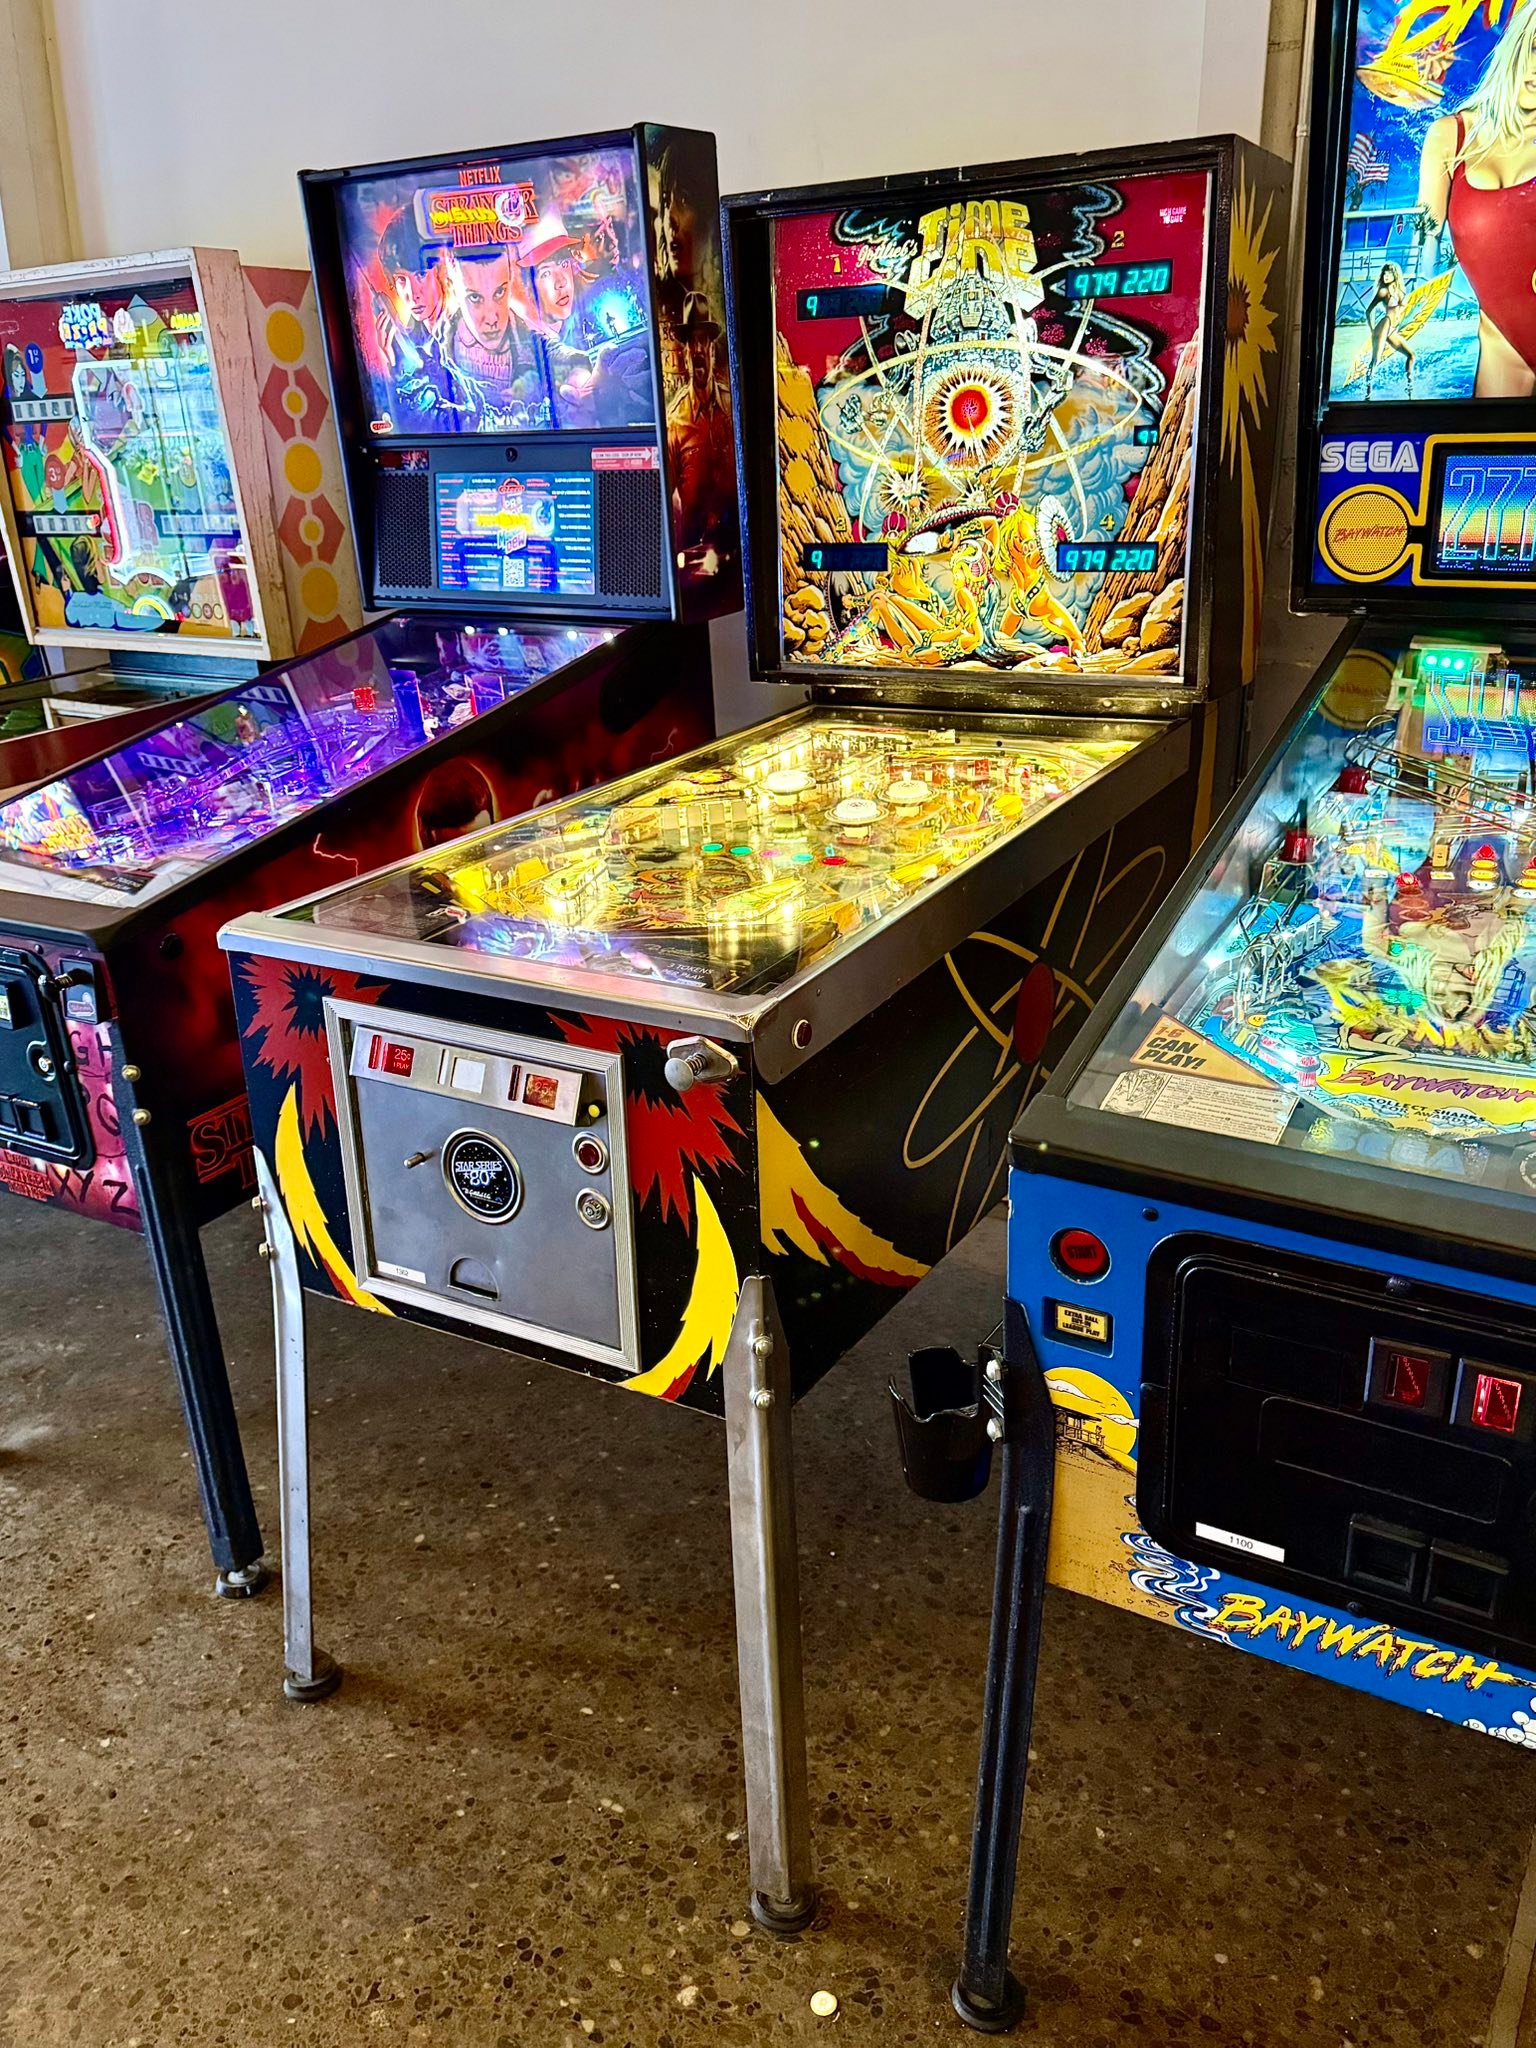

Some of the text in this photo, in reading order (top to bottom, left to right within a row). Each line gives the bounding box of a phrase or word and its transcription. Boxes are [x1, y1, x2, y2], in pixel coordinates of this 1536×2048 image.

[459, 166, 501, 187] NETFLIX
[451, 222, 524, 247] THINGS
[918, 199, 1035, 258] TIME
[1111, 230, 1125, 248] 2
[833, 257, 842, 274] 1
[1075, 266, 1170, 297] 979 220
[806, 295, 818, 318] 9
[1138, 429, 1158, 445] 97
[1320, 440, 1419, 473] SEGA
[1100, 513, 1115, 531] 4
[1333, 524, 1409, 544] BAYWATCH
[811, 550, 823, 569] 9
[1066, 549, 1155, 571] 979 220
[676, 964, 715, 975] TOKENS
[681, 971, 705, 980] PLAY
[1156, 1026, 1186, 1039] 1-6
[394, 1048, 411, 1061] 25¢
[1147, 1037, 1199, 1055] CAN
[1139, 1049, 1207, 1070] PLAY!
[1326, 1068, 1536, 1104] BAYWATCH
[1368, 1096, 1428, 1112] COLLECT
[1381, 1104, 1469, 1125] FOR AWARDS
[1433, 1108, 1486, 1122] SHARKS
[456, 1161, 502, 1170] STAR SERIES
[1064, 1309, 1098, 1324] EXTRA BALL
[1062, 1322, 1099, 1337] LEAGUE PLAY
[1230, 1536, 1254, 1550] 1100
[1207, 1592, 1520, 1692] BAYWATCH
